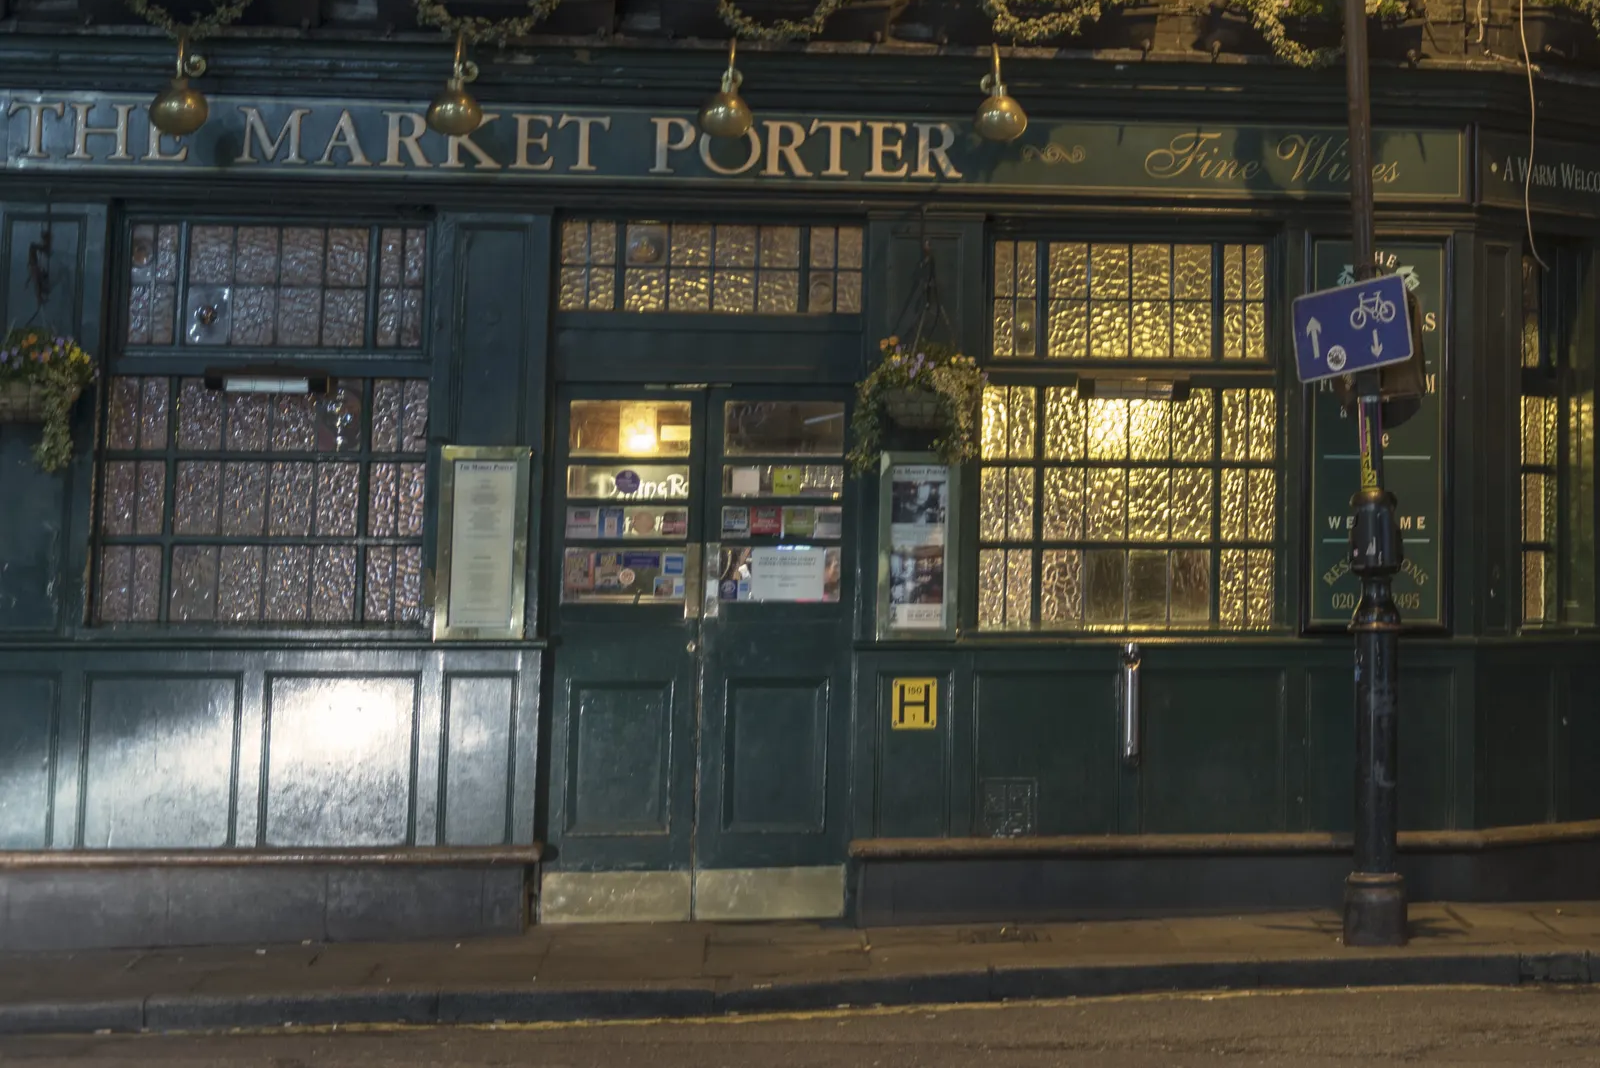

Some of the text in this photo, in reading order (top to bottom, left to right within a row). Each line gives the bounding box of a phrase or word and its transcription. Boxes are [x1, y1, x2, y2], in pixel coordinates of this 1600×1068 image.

[8, 101, 963, 179] THE MARKET PORTER
[1144, 132, 1401, 183] Fine Wies
[1503, 155, 1514, 183] A
[1328, 515, 1426, 530] WEME
[1331, 592, 1355, 609] 020
[899, 684, 930, 724] H
